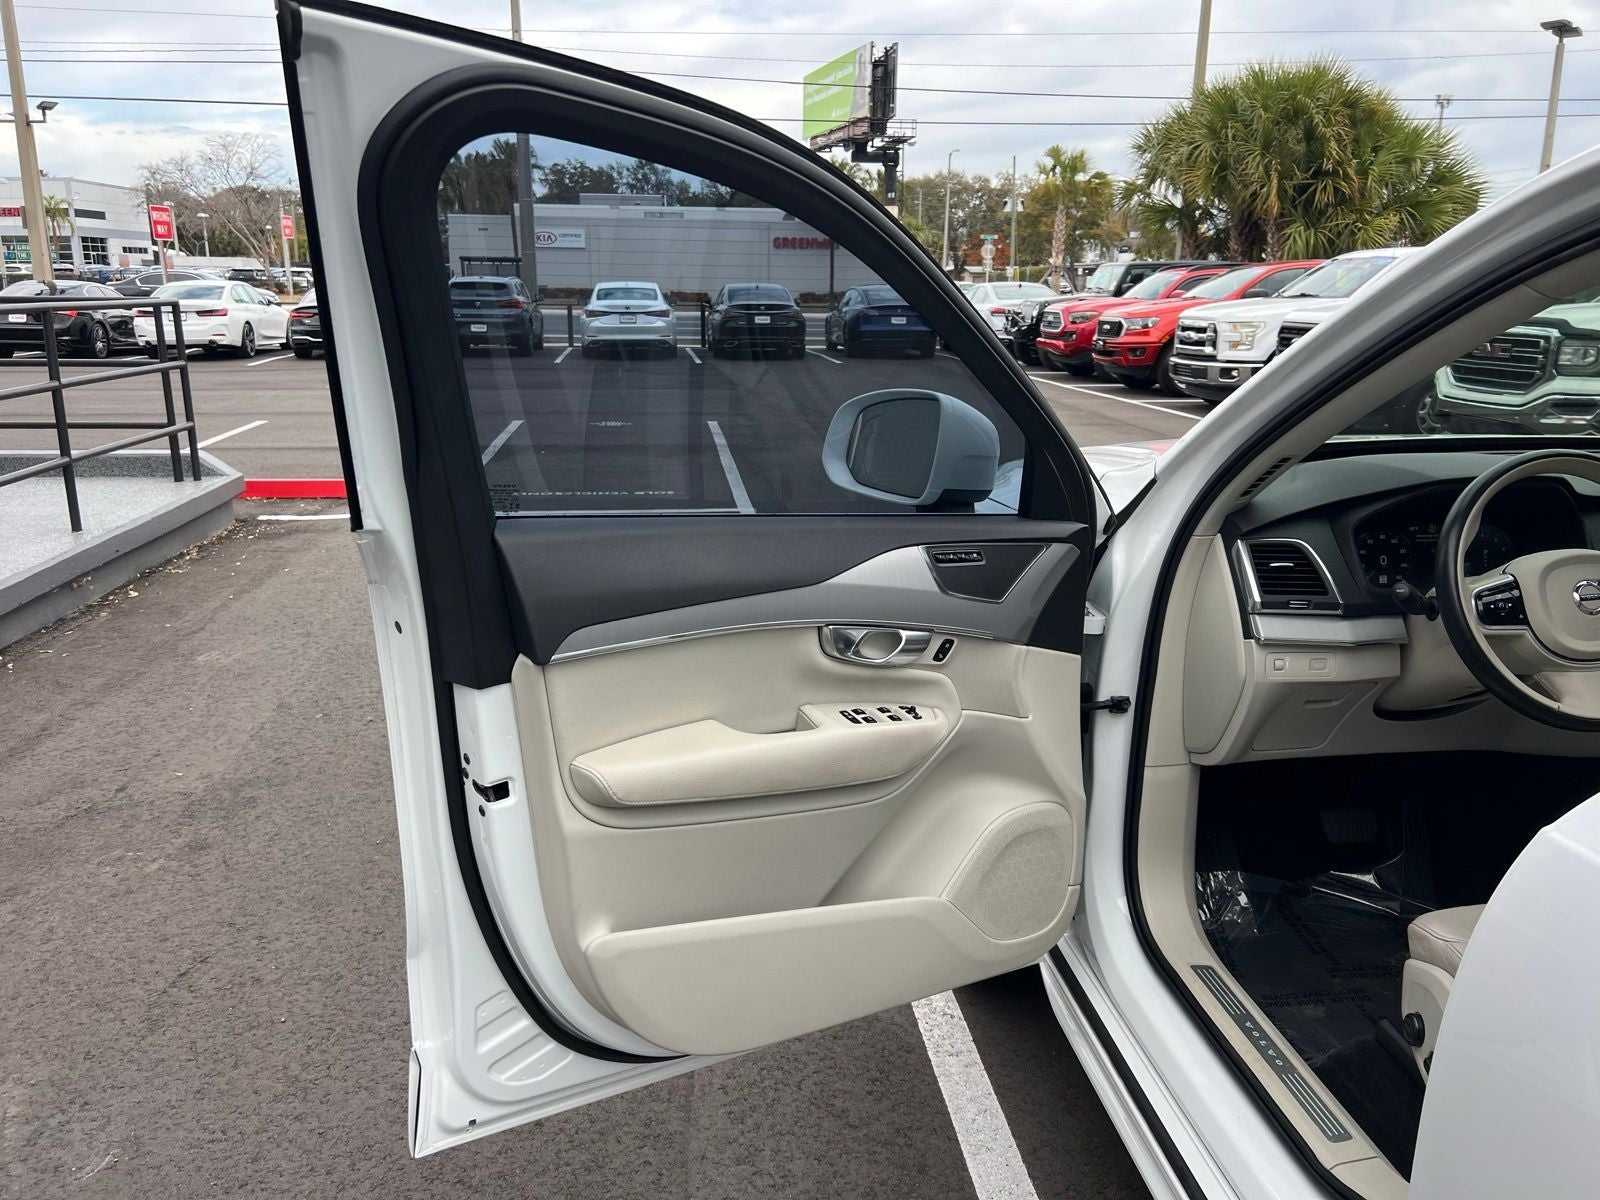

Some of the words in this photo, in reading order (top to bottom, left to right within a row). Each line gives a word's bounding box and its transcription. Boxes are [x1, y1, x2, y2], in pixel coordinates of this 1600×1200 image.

[151, 210, 170, 221] WRONG
[157, 225, 169, 235] WAY
[536, 234, 553, 242] KIA
[1245, 1021, 1283, 1066] VOLVO
